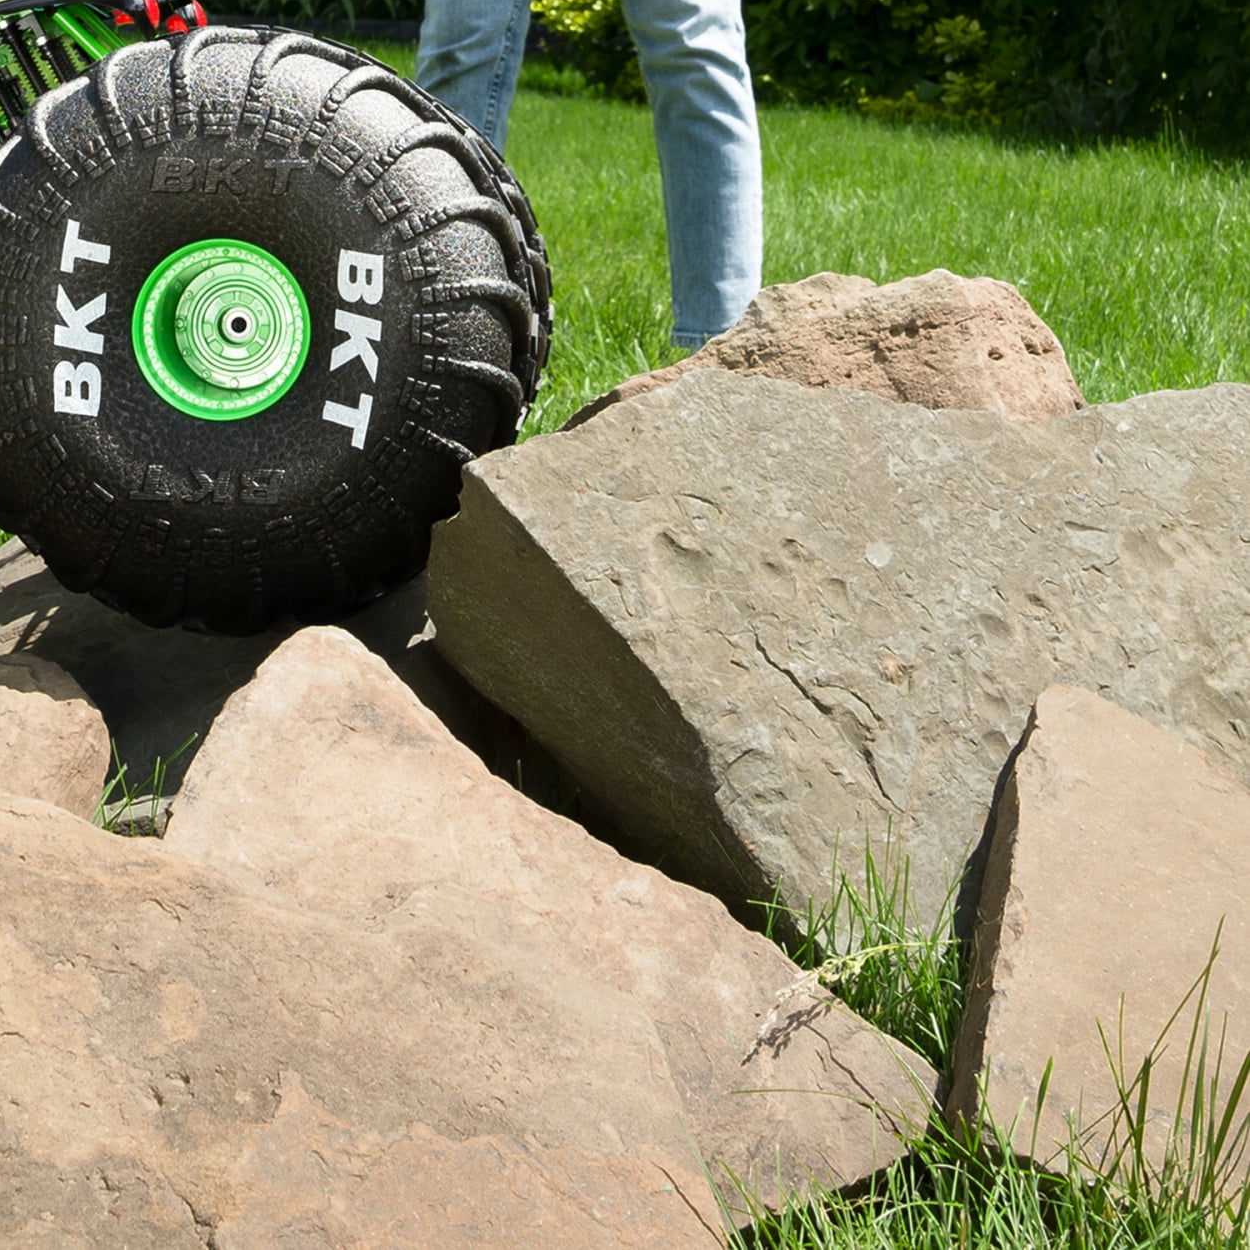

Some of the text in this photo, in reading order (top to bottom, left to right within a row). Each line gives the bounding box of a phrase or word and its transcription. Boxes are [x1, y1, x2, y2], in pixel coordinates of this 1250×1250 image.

[150, 155, 309, 196] BKT
[53, 219, 111, 417] BKT
[322, 249, 385, 450] BKT
[128, 464, 287, 505] BKT
